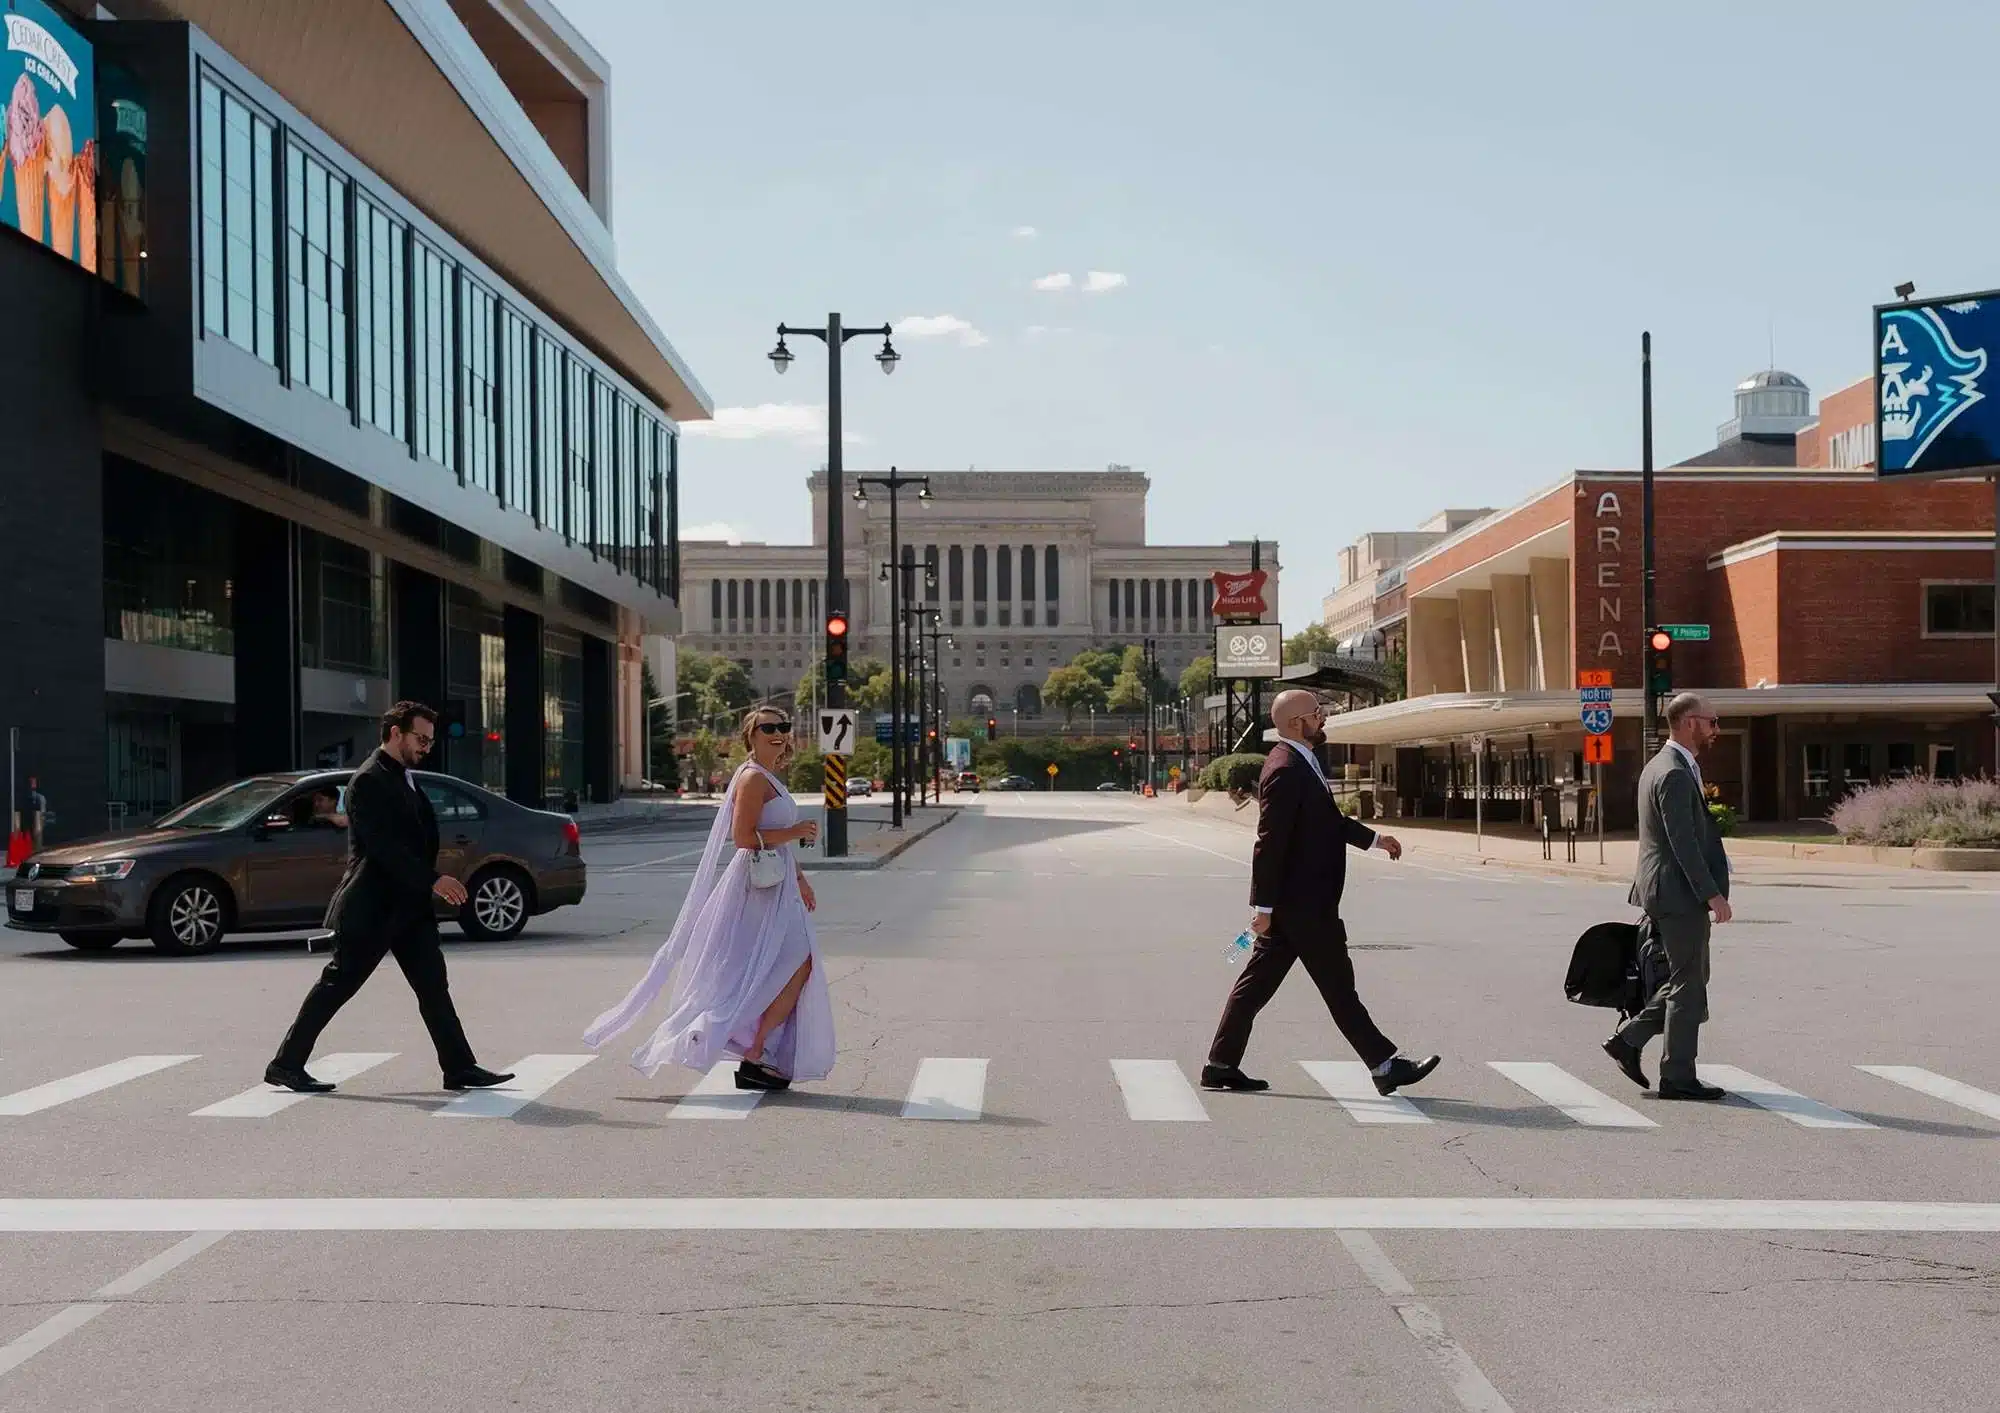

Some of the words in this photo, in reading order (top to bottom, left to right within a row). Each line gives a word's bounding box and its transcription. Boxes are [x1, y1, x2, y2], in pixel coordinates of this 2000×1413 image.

[12, 20, 42, 52] CEDAR
[44, 38, 71, 83] CREST
[25, 56, 37, 74] ICE
[37, 63, 60, 94] CREAM
[1596, 491, 1622, 657] ARENA
[1241, 595, 1257, 604] LIFE
[1582, 689, 1611, 700] NORTH
[1584, 710, 1610, 728] 43
